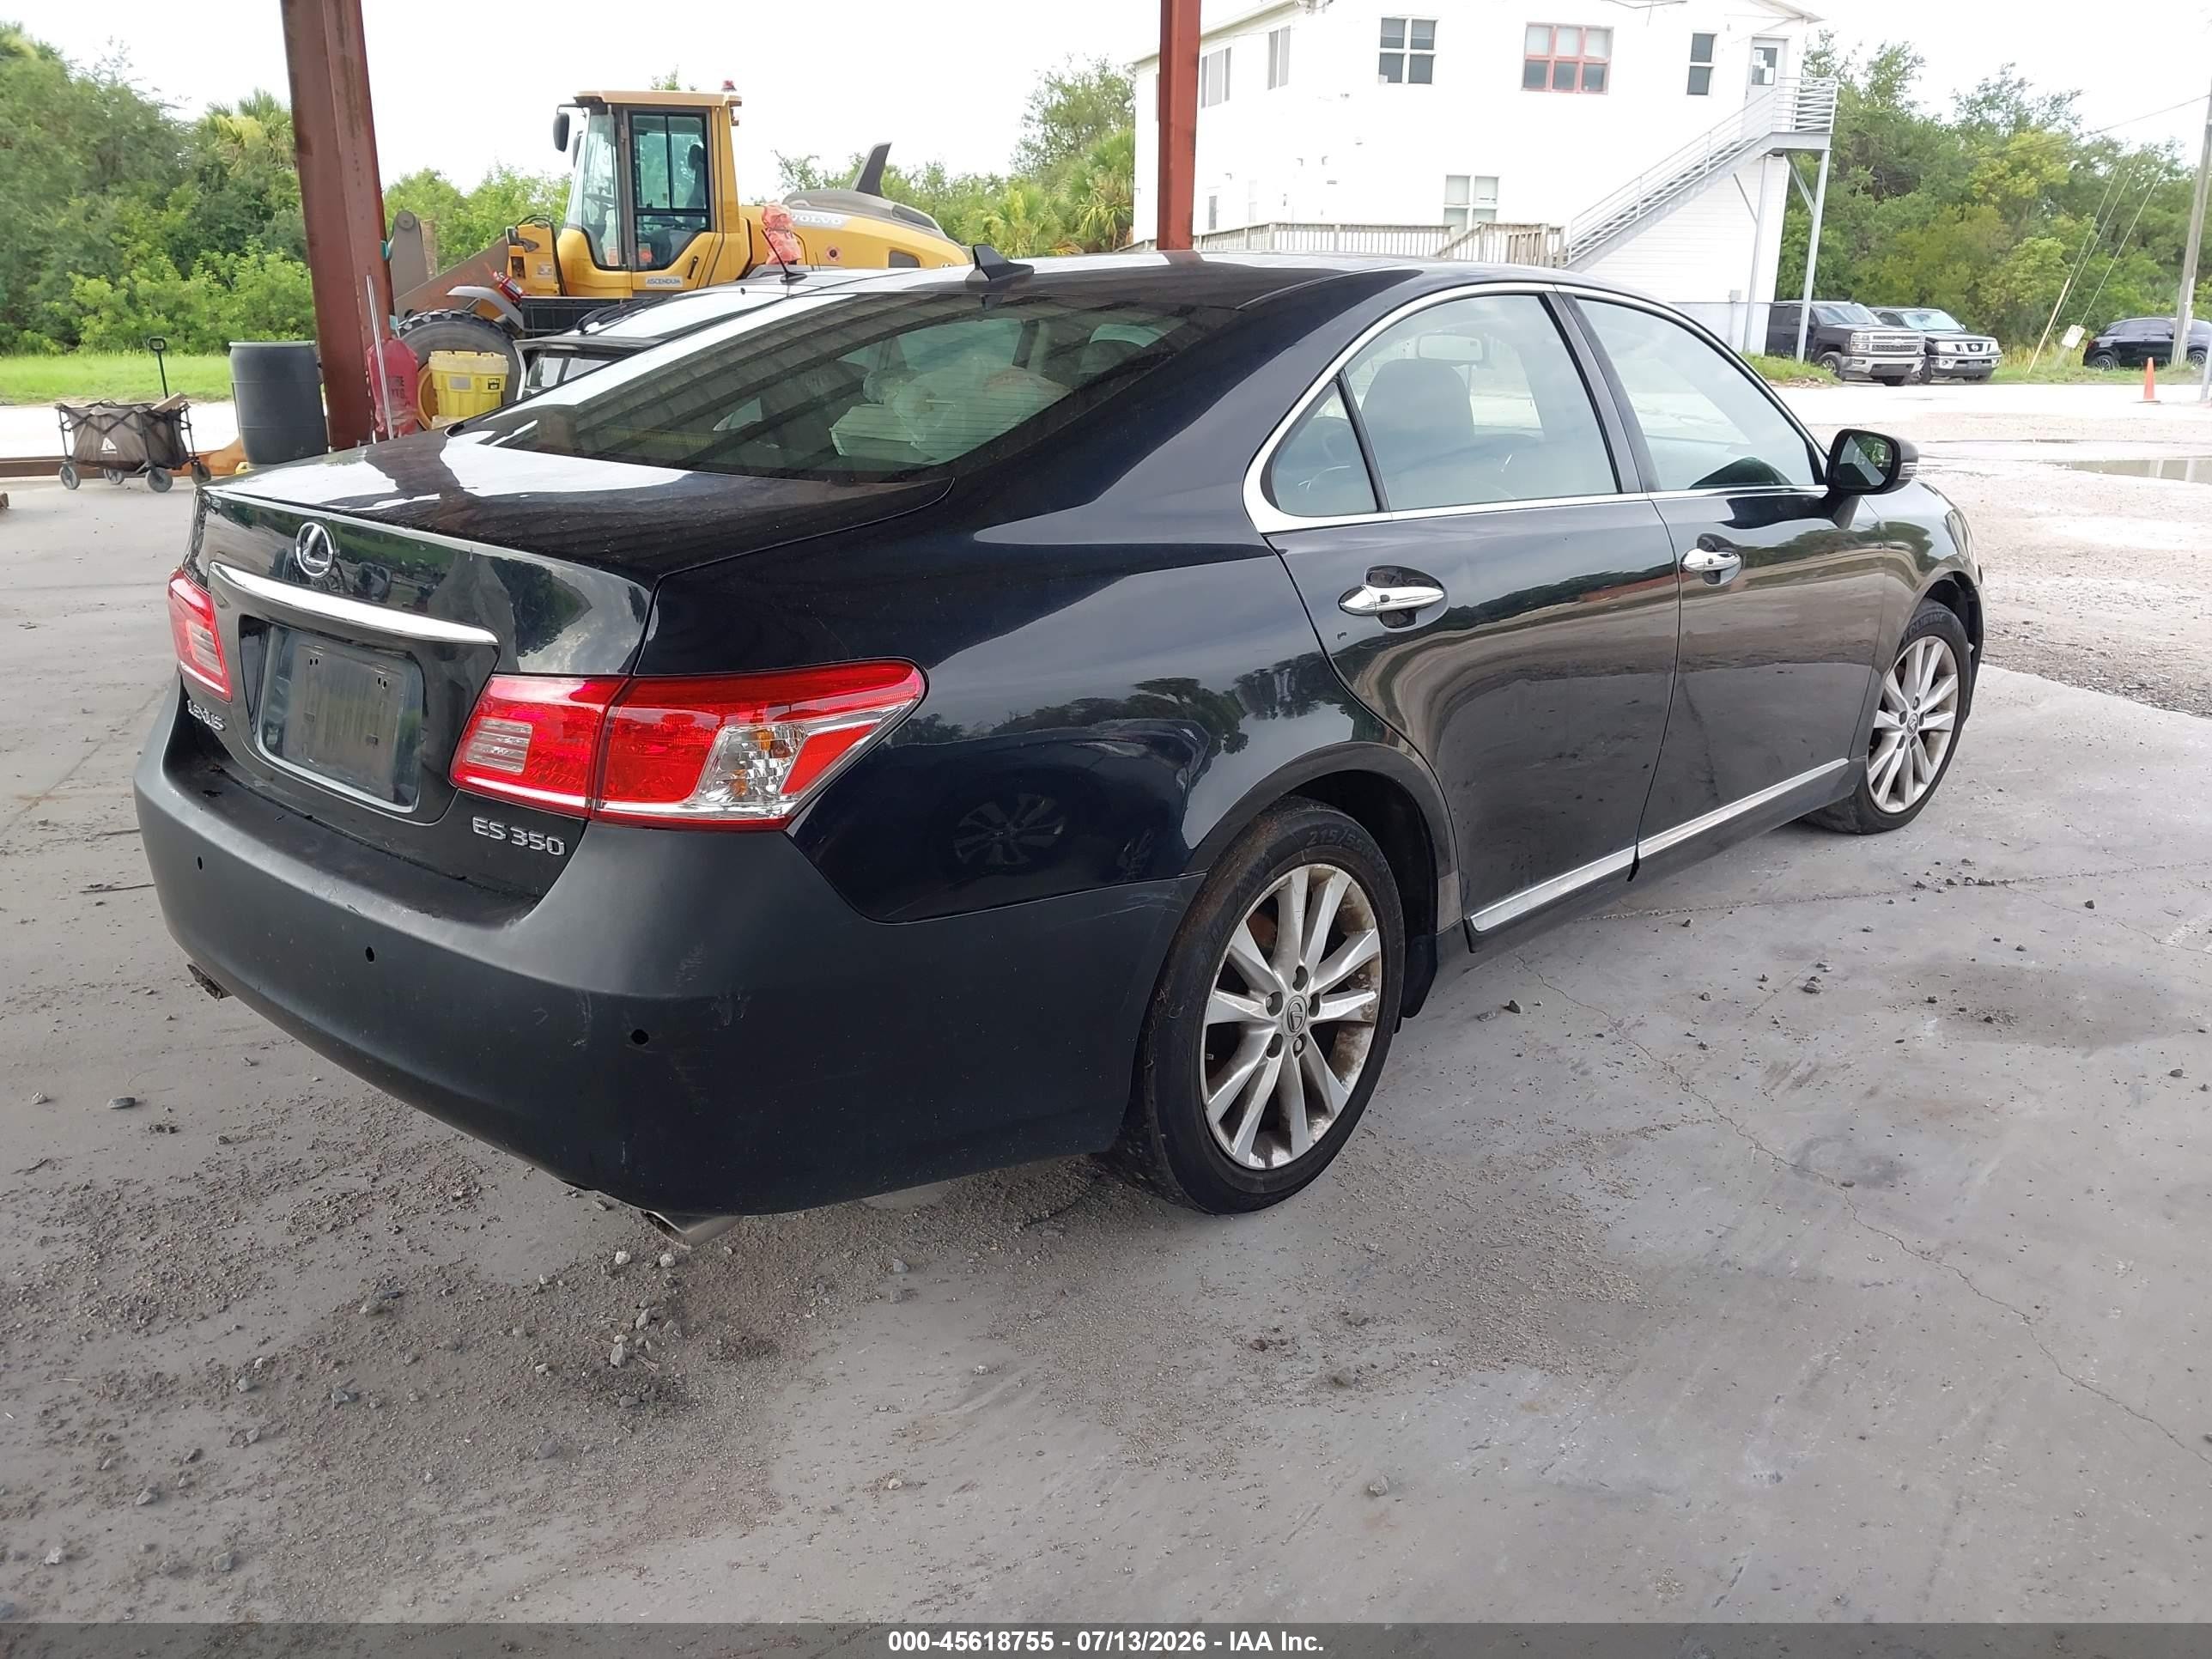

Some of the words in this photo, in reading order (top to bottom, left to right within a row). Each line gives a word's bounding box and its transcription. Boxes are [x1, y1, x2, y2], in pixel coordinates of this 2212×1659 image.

[791, 214, 842, 223] VOLVO
[472, 817, 507, 840] ES
[510, 826, 565, 855] 350
